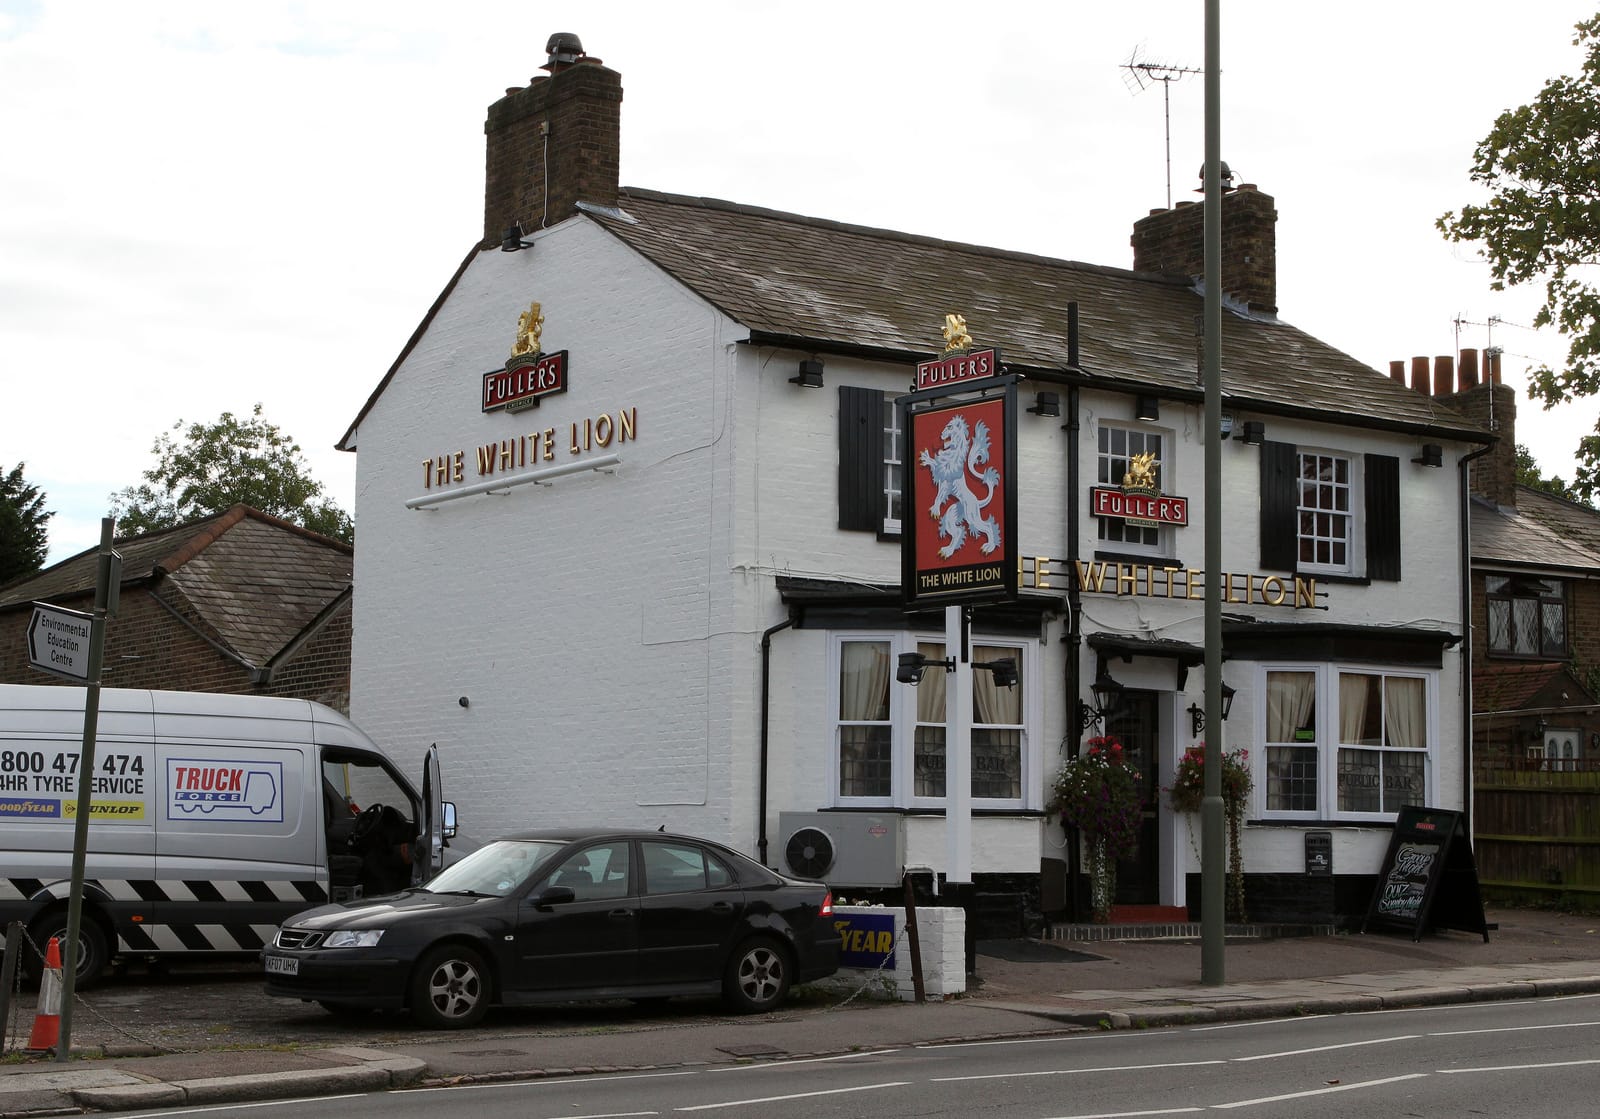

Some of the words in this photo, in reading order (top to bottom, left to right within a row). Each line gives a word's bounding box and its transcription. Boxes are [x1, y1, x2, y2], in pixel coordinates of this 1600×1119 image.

[487, 361, 556, 402] FULLER'S
[921, 356, 988, 385] FULLER'S
[422, 450, 464, 489] THE
[476, 427, 555, 475] WHITE
[569, 406, 637, 455] LION
[1100, 493, 1182, 520] FULLER'S
[921, 575, 940, 588] THE
[942, 570, 973, 585] WHITE
[976, 567, 1001, 582] LION
[1075, 559, 1201, 600] WHITE
[1226, 572, 1316, 609] LION
[42, 615, 88, 638] Environmental
[48, 632, 79, 652] Education
[51, 650, 73, 667] Centre
[52, 753, 94, 774] 47
[103, 755, 144, 776] 474
[33, 776, 73, 792] TYRE
[79, 777, 144, 794] ERVICE
[175, 767, 244, 792] TRUCK
[1339, 773, 1380, 788] PUBLIC
[1385, 775, 1413, 790] BAR
[177, 792, 238, 801] FORCE
[88, 805, 141, 814] UNLOP
